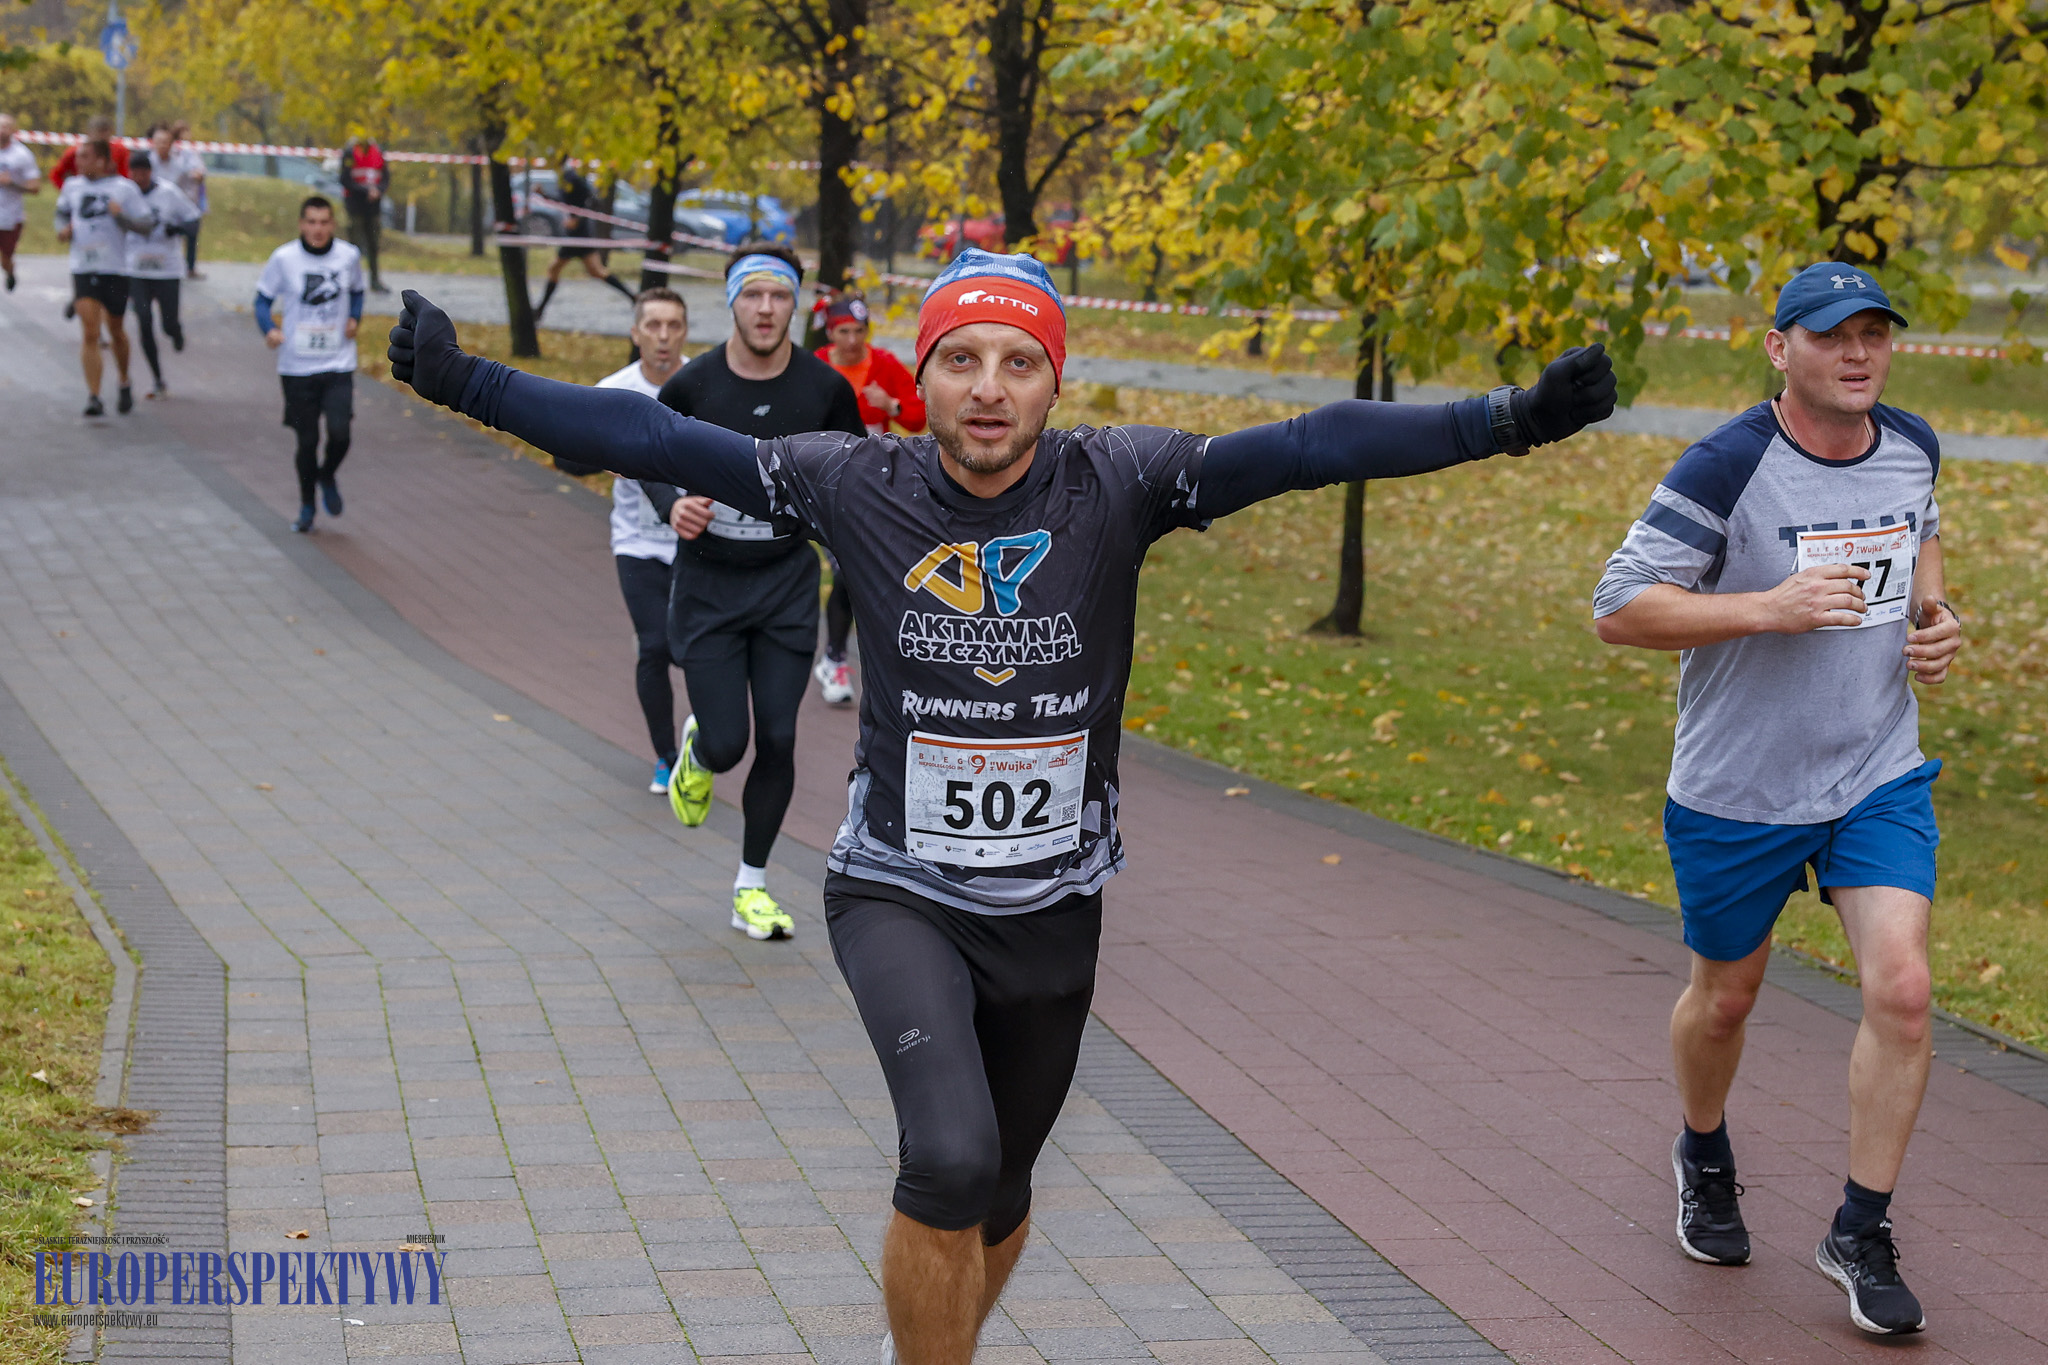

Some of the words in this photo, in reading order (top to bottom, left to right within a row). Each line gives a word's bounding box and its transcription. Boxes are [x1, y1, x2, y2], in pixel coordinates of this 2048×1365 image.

[982, 294, 1039, 317] ATTIQ
[900, 610, 1077, 645] AKTYWNA
[899, 636, 1083, 666] PSZCZYNA.PL
[1030, 685, 1090, 719] TEAM
[918, 752, 964, 765] BIEG
[989, 759, 1038, 773] "Wujka"
[942, 778, 1052, 831] 502
